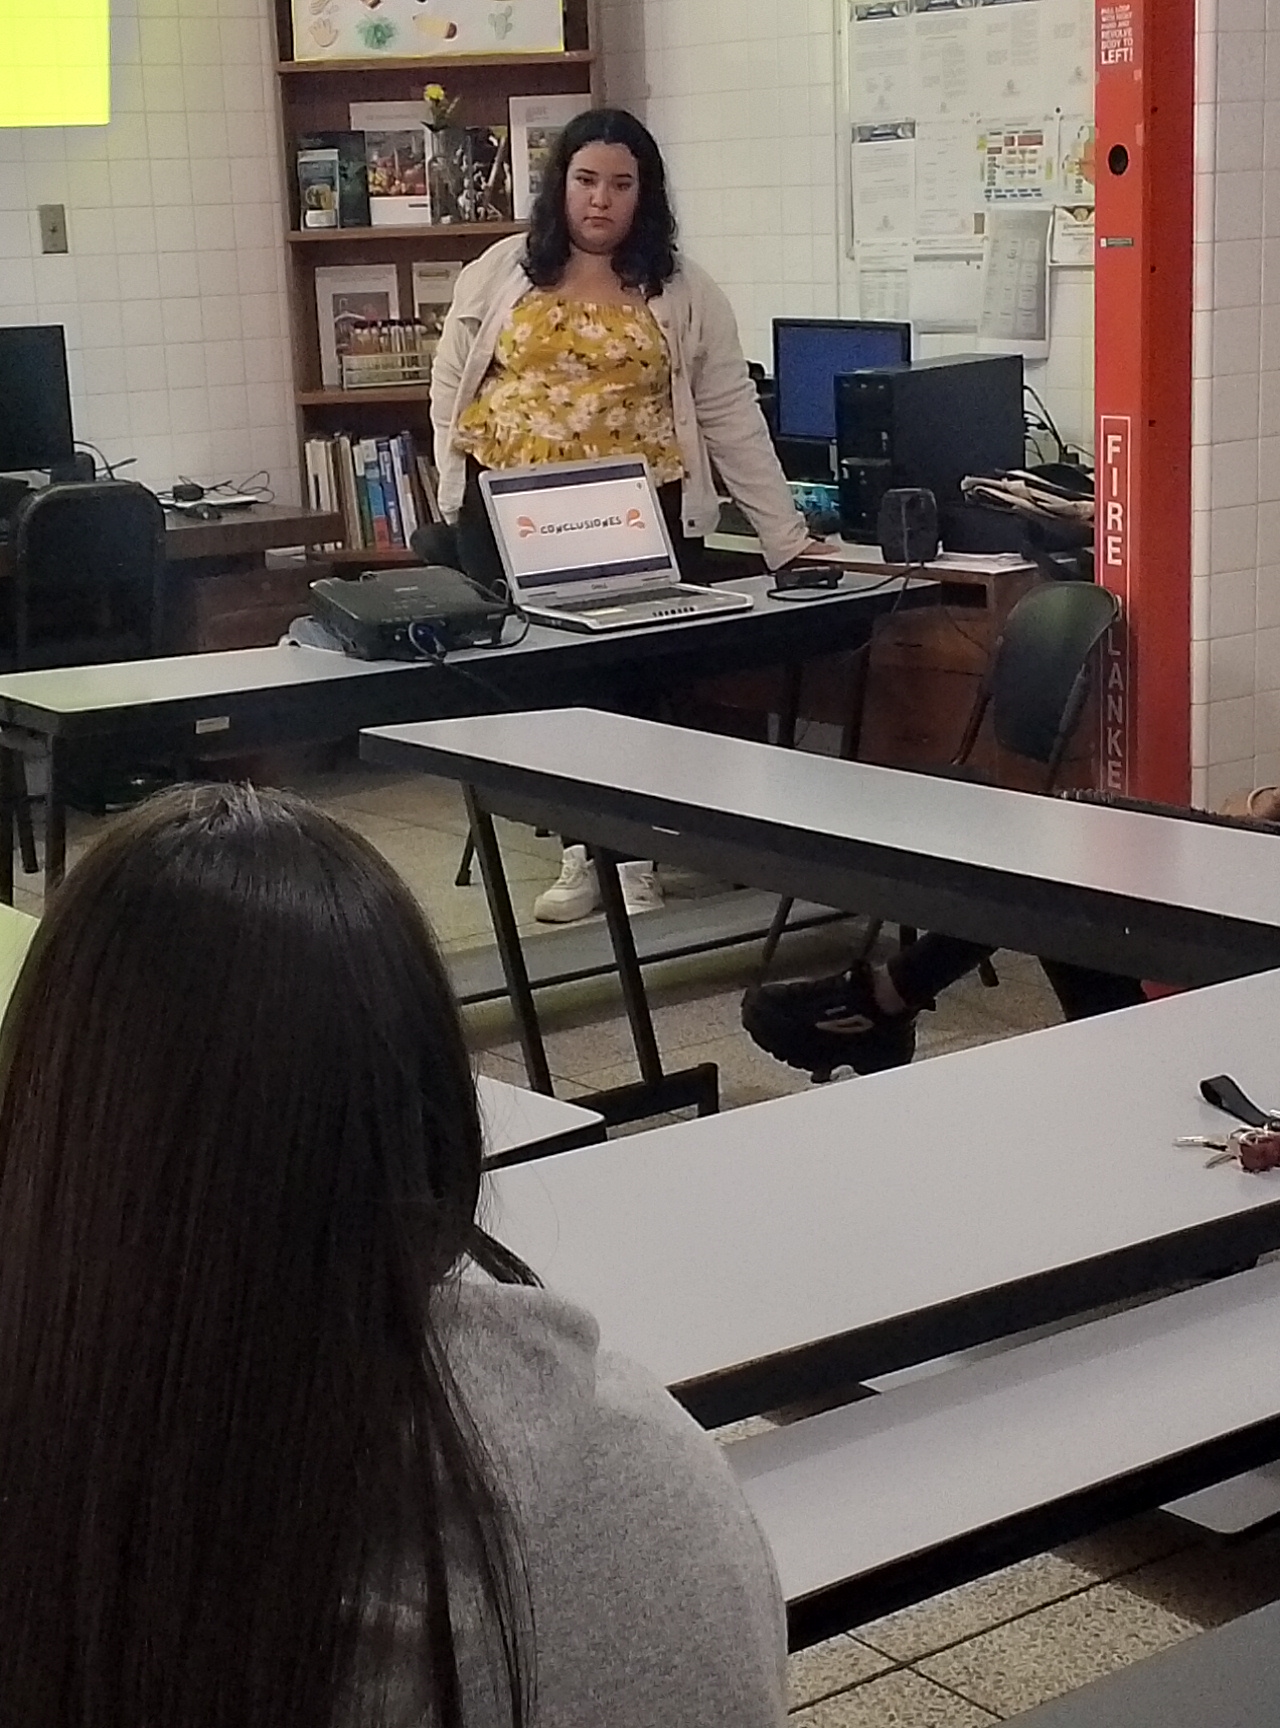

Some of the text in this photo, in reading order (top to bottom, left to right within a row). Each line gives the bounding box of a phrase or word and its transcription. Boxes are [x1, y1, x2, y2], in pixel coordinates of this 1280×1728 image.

[1101, 27, 1133, 39] REVOLVE
[1101, 37, 1134, 50] BODY TO
[1101, 47, 1134, 65] LEFT!
[1107, 434, 1123, 566] FIRE
[540, 515, 622, 534] CONCLUSIONES
